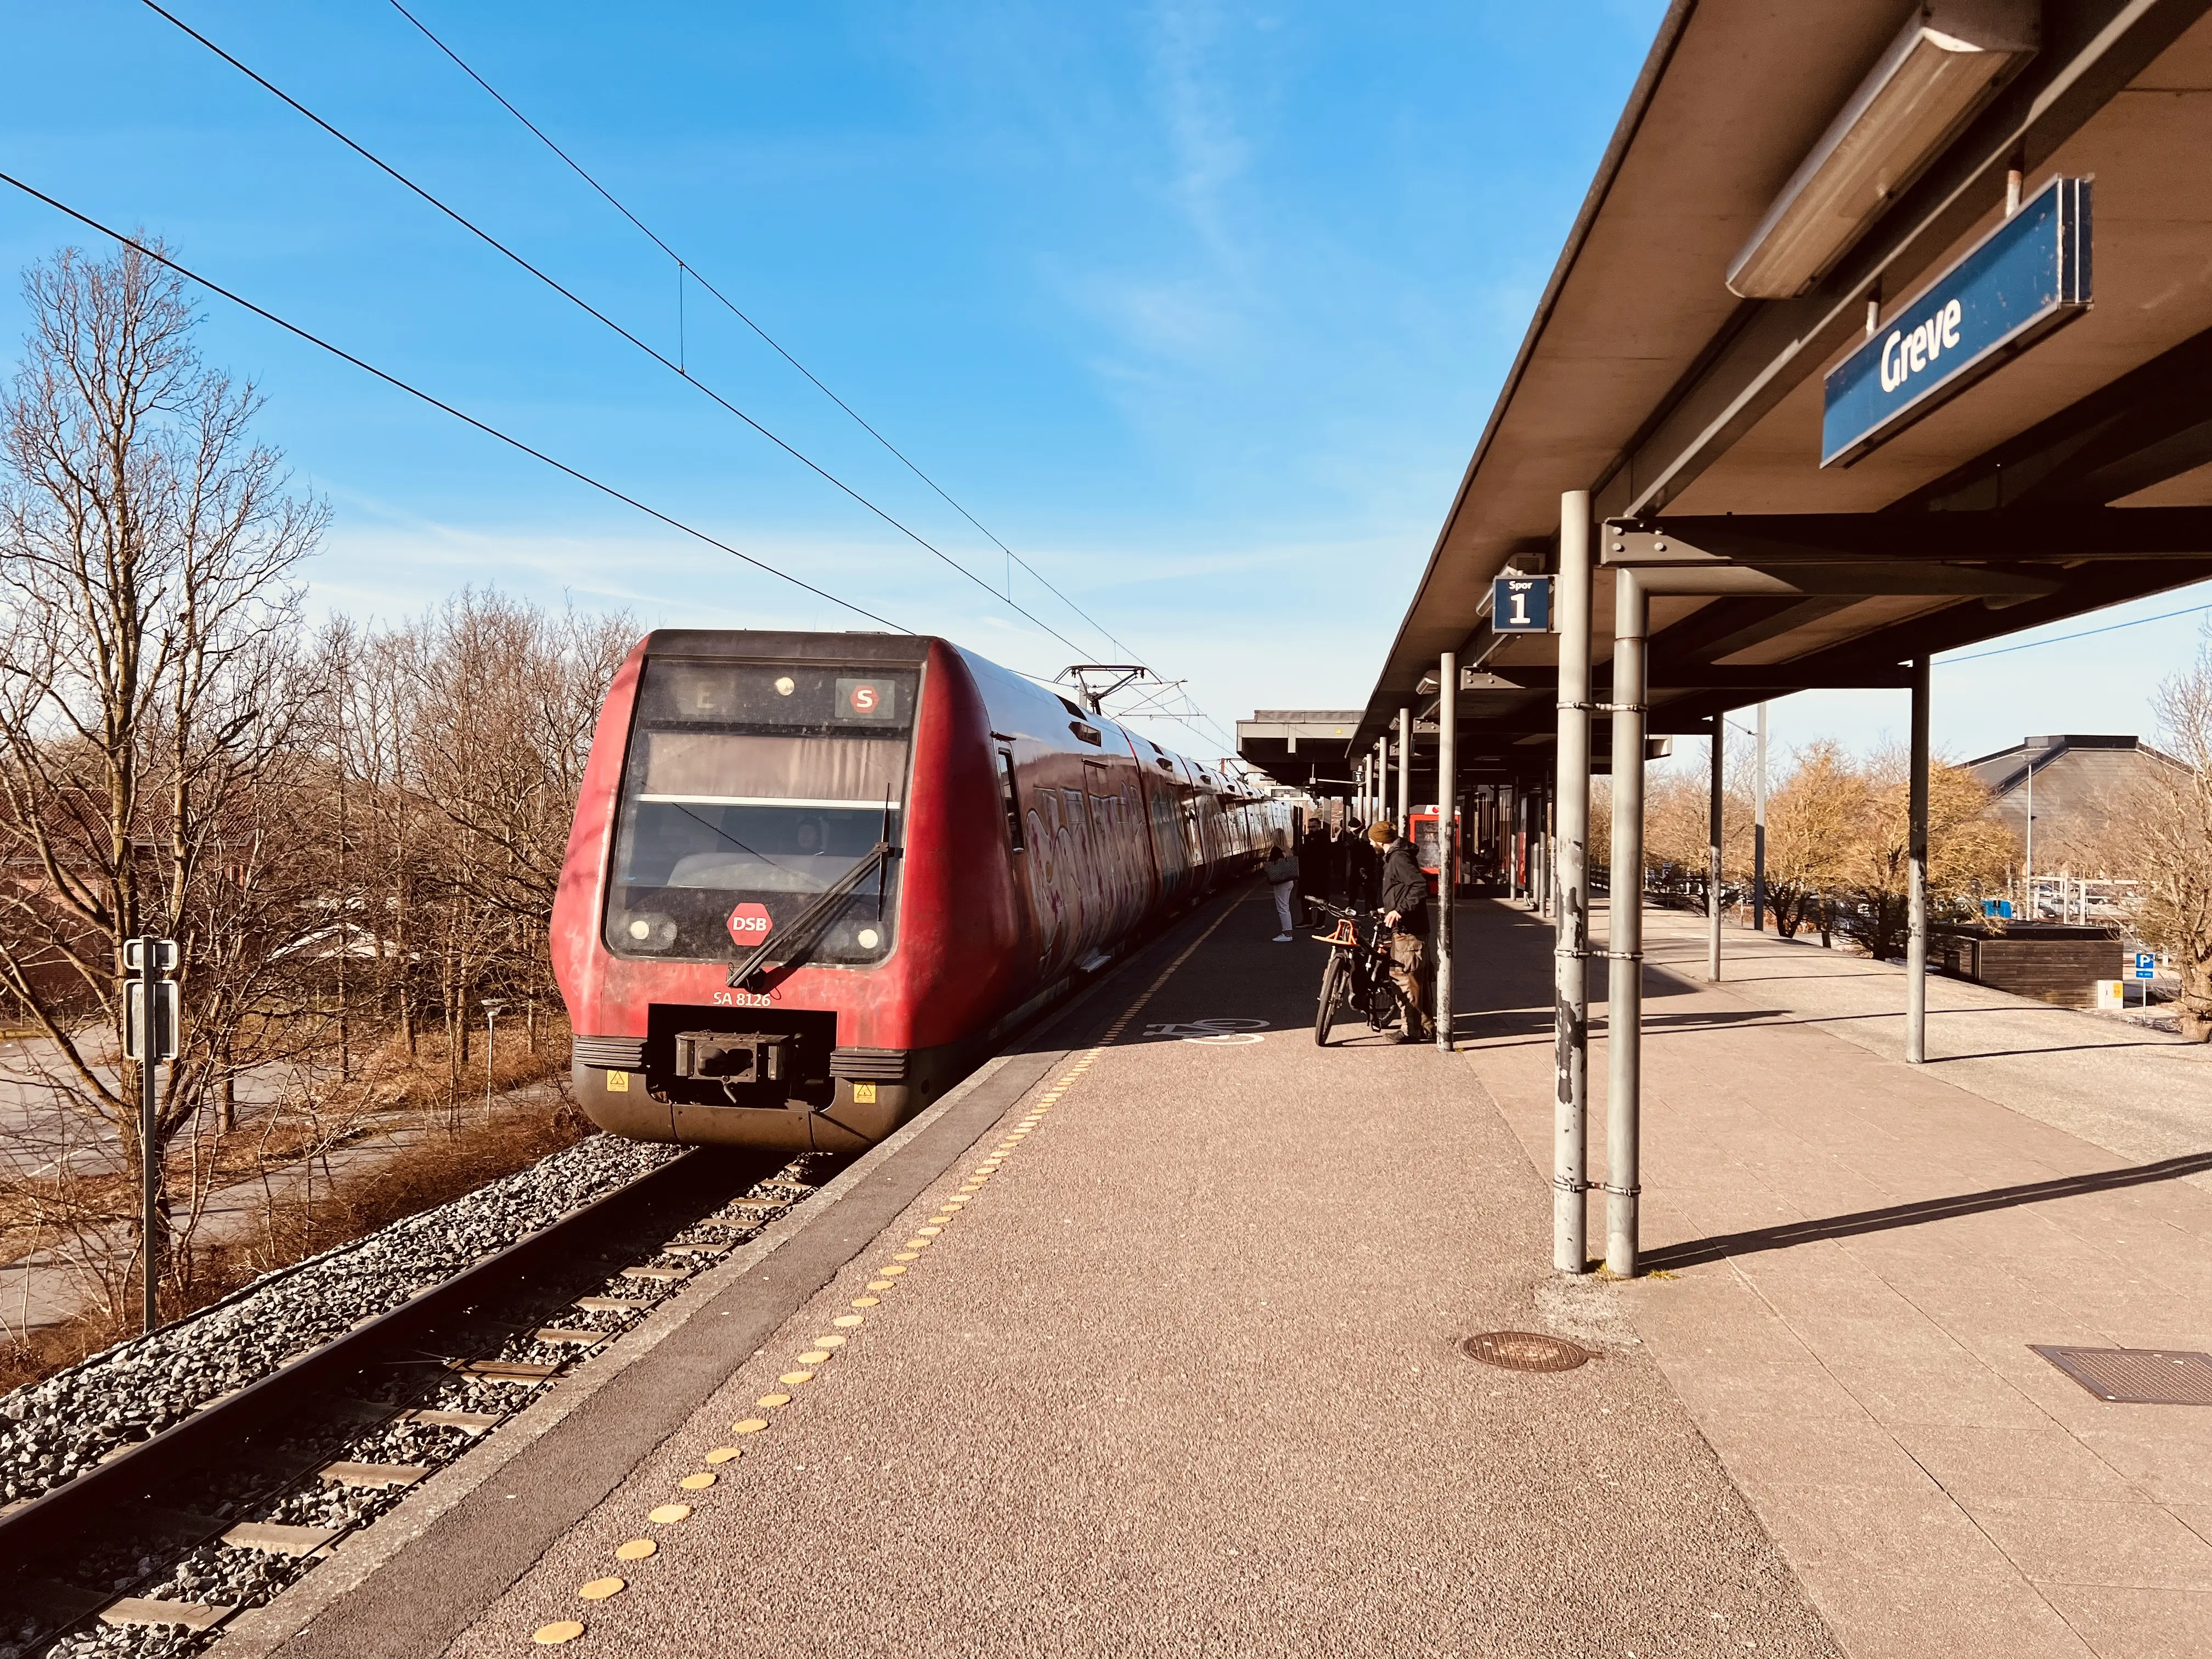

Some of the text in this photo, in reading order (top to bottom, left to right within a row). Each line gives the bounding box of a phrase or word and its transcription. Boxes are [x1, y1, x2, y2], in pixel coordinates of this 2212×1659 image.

[1881, 298, 1962, 393] Greve
[1509, 580, 1533, 591] Spor
[1510, 593, 1531, 624] 1
[856, 690, 873, 708] S
[732, 917, 768, 932] DSB
[2140, 955, 2151, 967] P
[713, 991, 771, 1007] SA 8126
